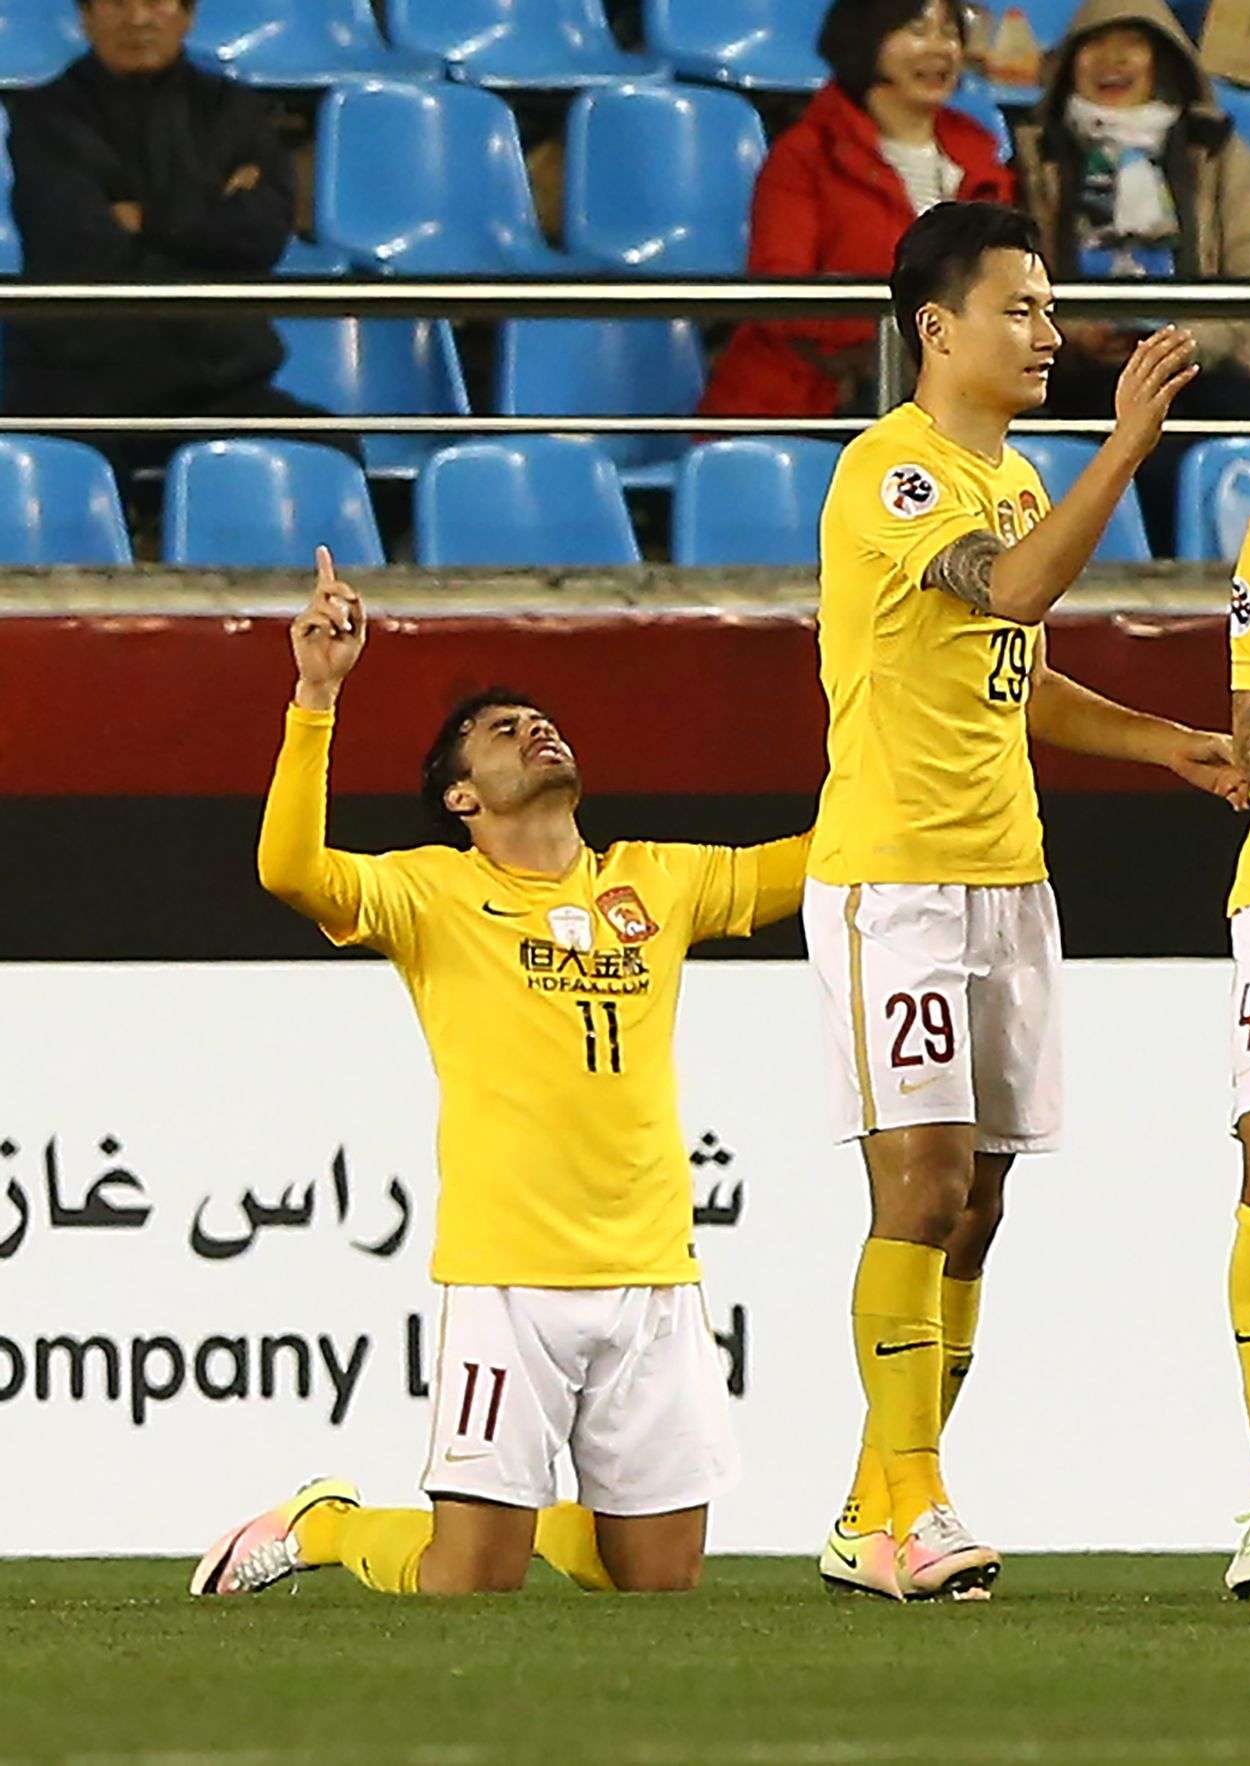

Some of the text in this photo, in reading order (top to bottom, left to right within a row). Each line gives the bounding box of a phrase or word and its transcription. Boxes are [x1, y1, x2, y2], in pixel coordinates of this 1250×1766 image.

[988, 627, 1028, 703] 29
[576, 1000, 621, 1073] 11
[886, 992, 955, 1068] 29
[457, 1362, 507, 1442] 11
